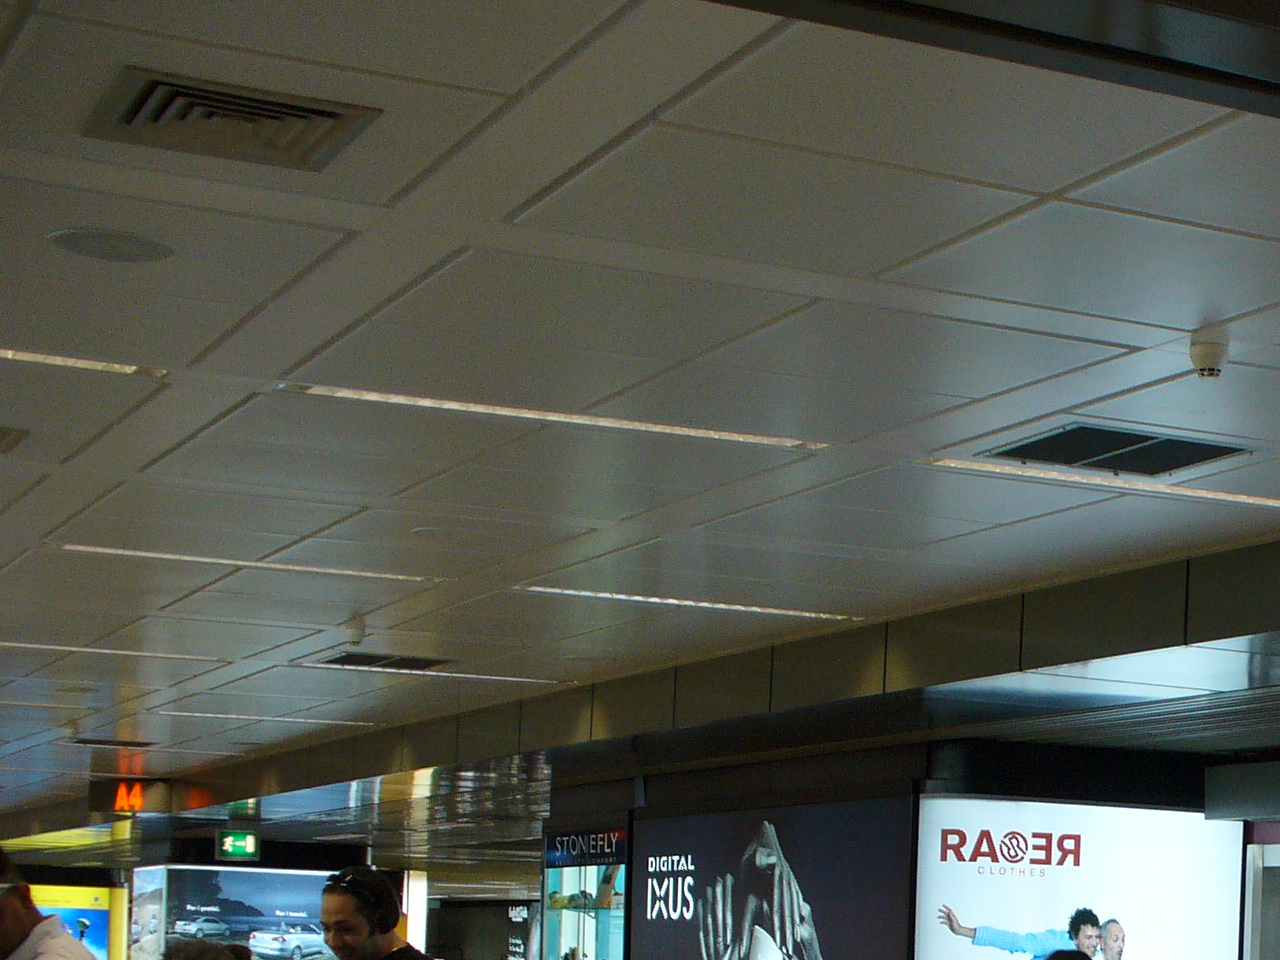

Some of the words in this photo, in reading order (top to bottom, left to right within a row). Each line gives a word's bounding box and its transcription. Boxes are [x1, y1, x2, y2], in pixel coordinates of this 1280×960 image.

[114, 782, 144, 811] A4
[555, 832, 619, 856] STONEFLY
[647, 854, 696, 873] DIGITAL
[977, 865, 1047, 878] CLOTHES
[646, 875, 695, 920] IXUS
